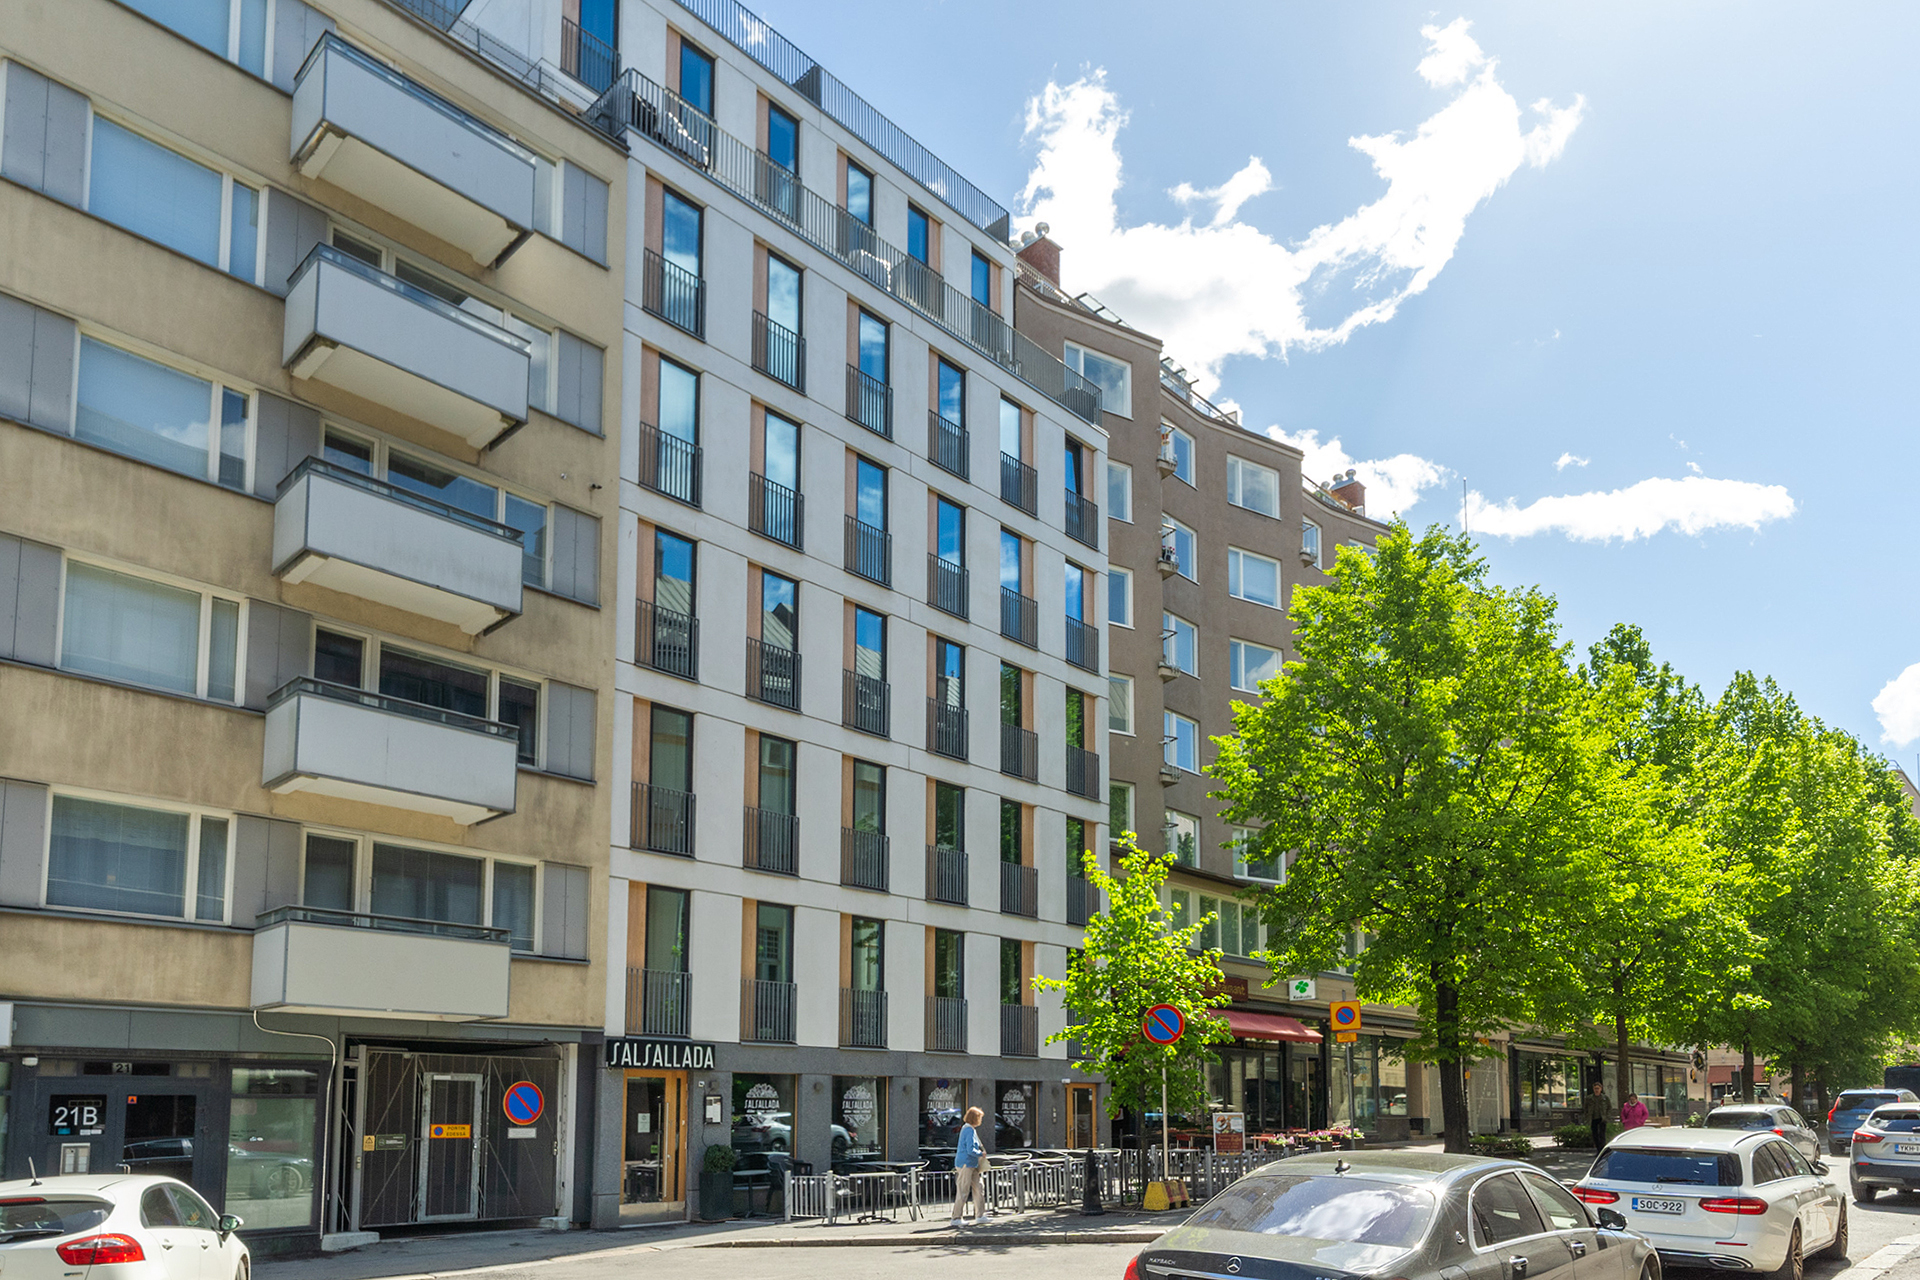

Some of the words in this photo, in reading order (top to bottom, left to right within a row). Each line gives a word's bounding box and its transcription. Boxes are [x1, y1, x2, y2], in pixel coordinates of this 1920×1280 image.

[610, 1042, 714, 1069] SALSALLADA
[116, 1063, 130, 1073] 21
[744, 1099, 780, 1109] SALSALLADA
[842, 1100, 873, 1110] SALSALLADA
[54, 1106, 98, 1126] 21B
[1639, 1199, 1682, 1212] SOC-922
[1148, 1257, 1176, 1265] MAYBACH
